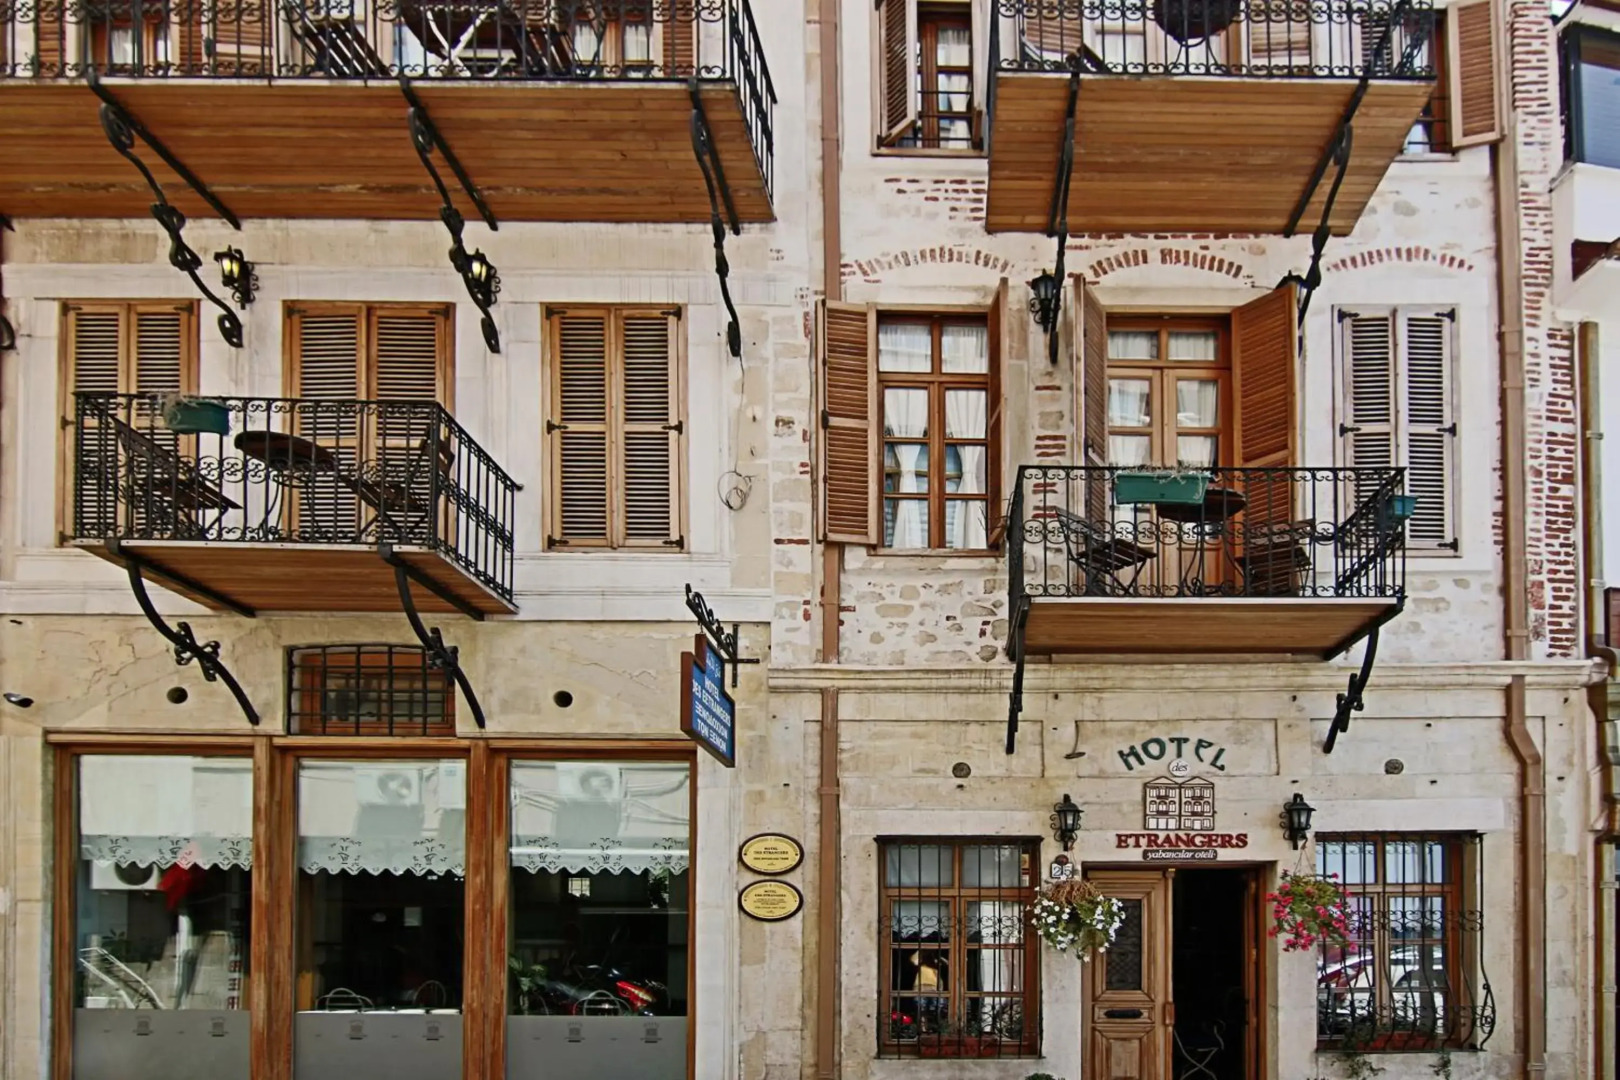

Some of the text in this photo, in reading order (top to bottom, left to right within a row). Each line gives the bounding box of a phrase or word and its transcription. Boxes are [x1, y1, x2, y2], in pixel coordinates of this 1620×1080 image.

[1117, 737, 1226, 771] HOTEL
[1172, 761, 1189, 772] des
[1115, 833, 1248, 849] ETRANGERS
[1195, 850, 1214, 859] oteli
[1053, 865, 1073, 877] 25
